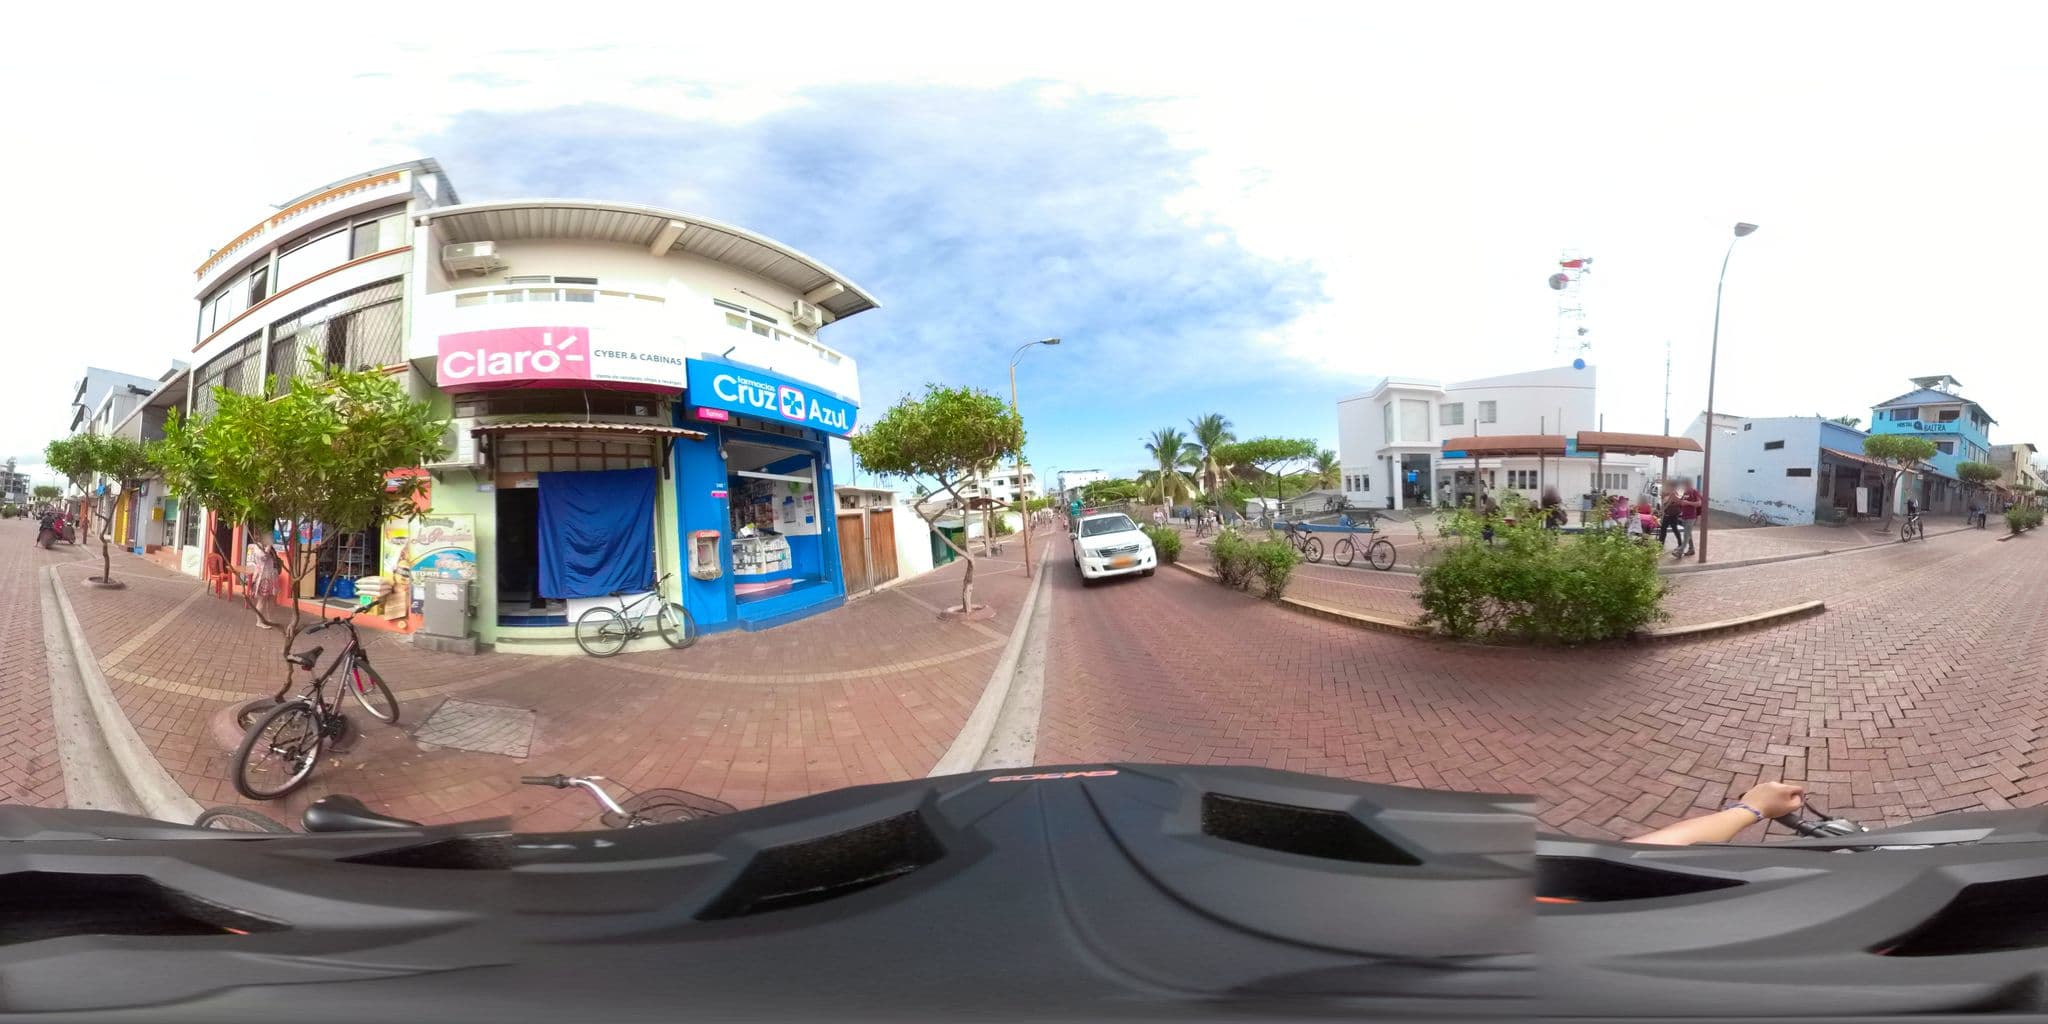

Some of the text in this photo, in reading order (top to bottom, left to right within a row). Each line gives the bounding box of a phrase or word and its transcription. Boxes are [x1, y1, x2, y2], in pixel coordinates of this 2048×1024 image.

[443, 348, 561, 379] Claro
[594, 349, 682, 366] CYBER & CABINAS
[713, 374, 849, 430] Cruz Azul
